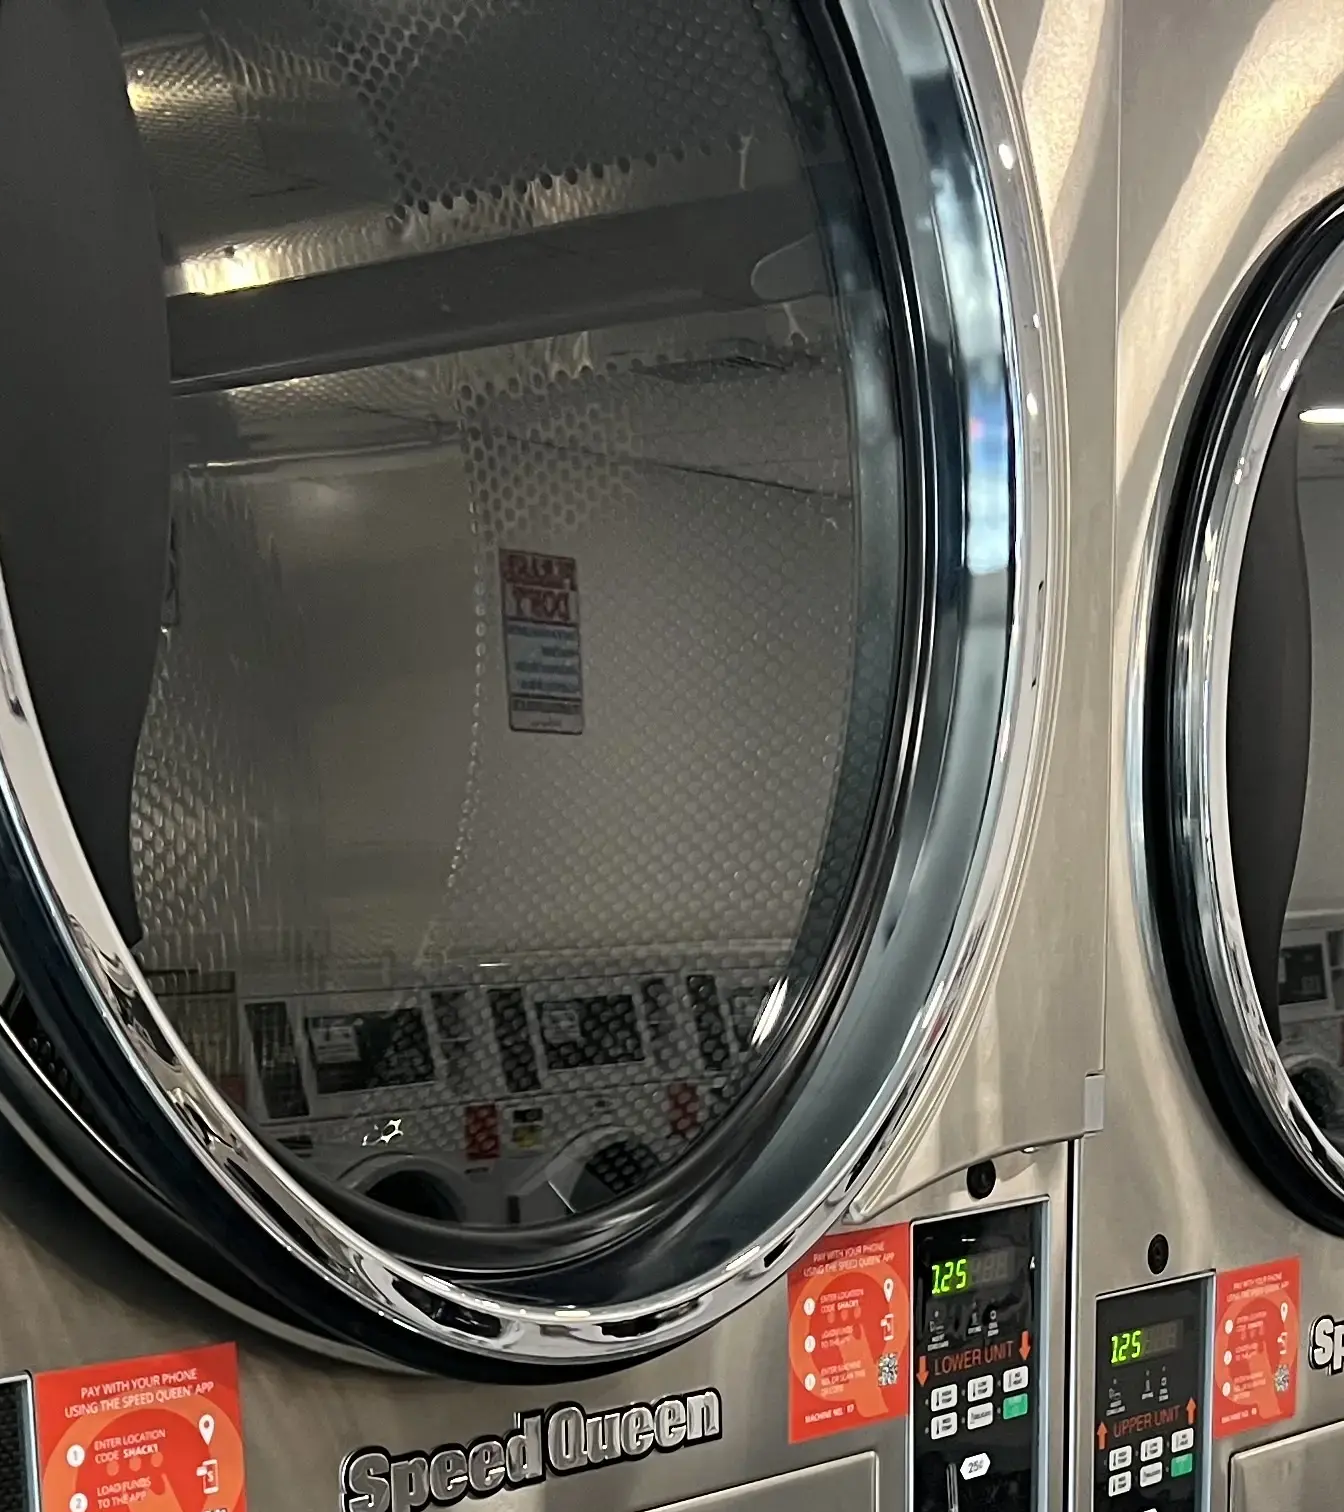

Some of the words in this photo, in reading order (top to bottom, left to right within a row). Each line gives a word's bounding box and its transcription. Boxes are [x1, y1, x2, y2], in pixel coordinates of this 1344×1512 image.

[934, 1348, 981, 1375] LOWER
[985, 1341, 1014, 1363] UNIT
[81, 1387, 100, 1399] PAY
[102, 1381, 130, 1394] WITH
[132, 1375, 160, 1390] YOUR
[162, 1368, 197, 1384] PHONE
[65, 1402, 98, 1418] USING
[100, 1398, 120, 1411] THE
[122, 1393, 154, 1408] SPEED
[195, 1382, 214, 1395] APP
[94, 1437, 122, 1451] ENTER
[123, 1429, 166, 1445] LOCATION
[546, 1388, 722, 1476] Queen
[95, 1450, 119, 1464] CODE
[97, 1483, 121, 1497] LOAD
[123, 1477, 151, 1491] FUNDS
[98, 1499, 110, 1509] TO
[112, 1494, 128, 1505] THE
[129, 1490, 146, 1502] APP
